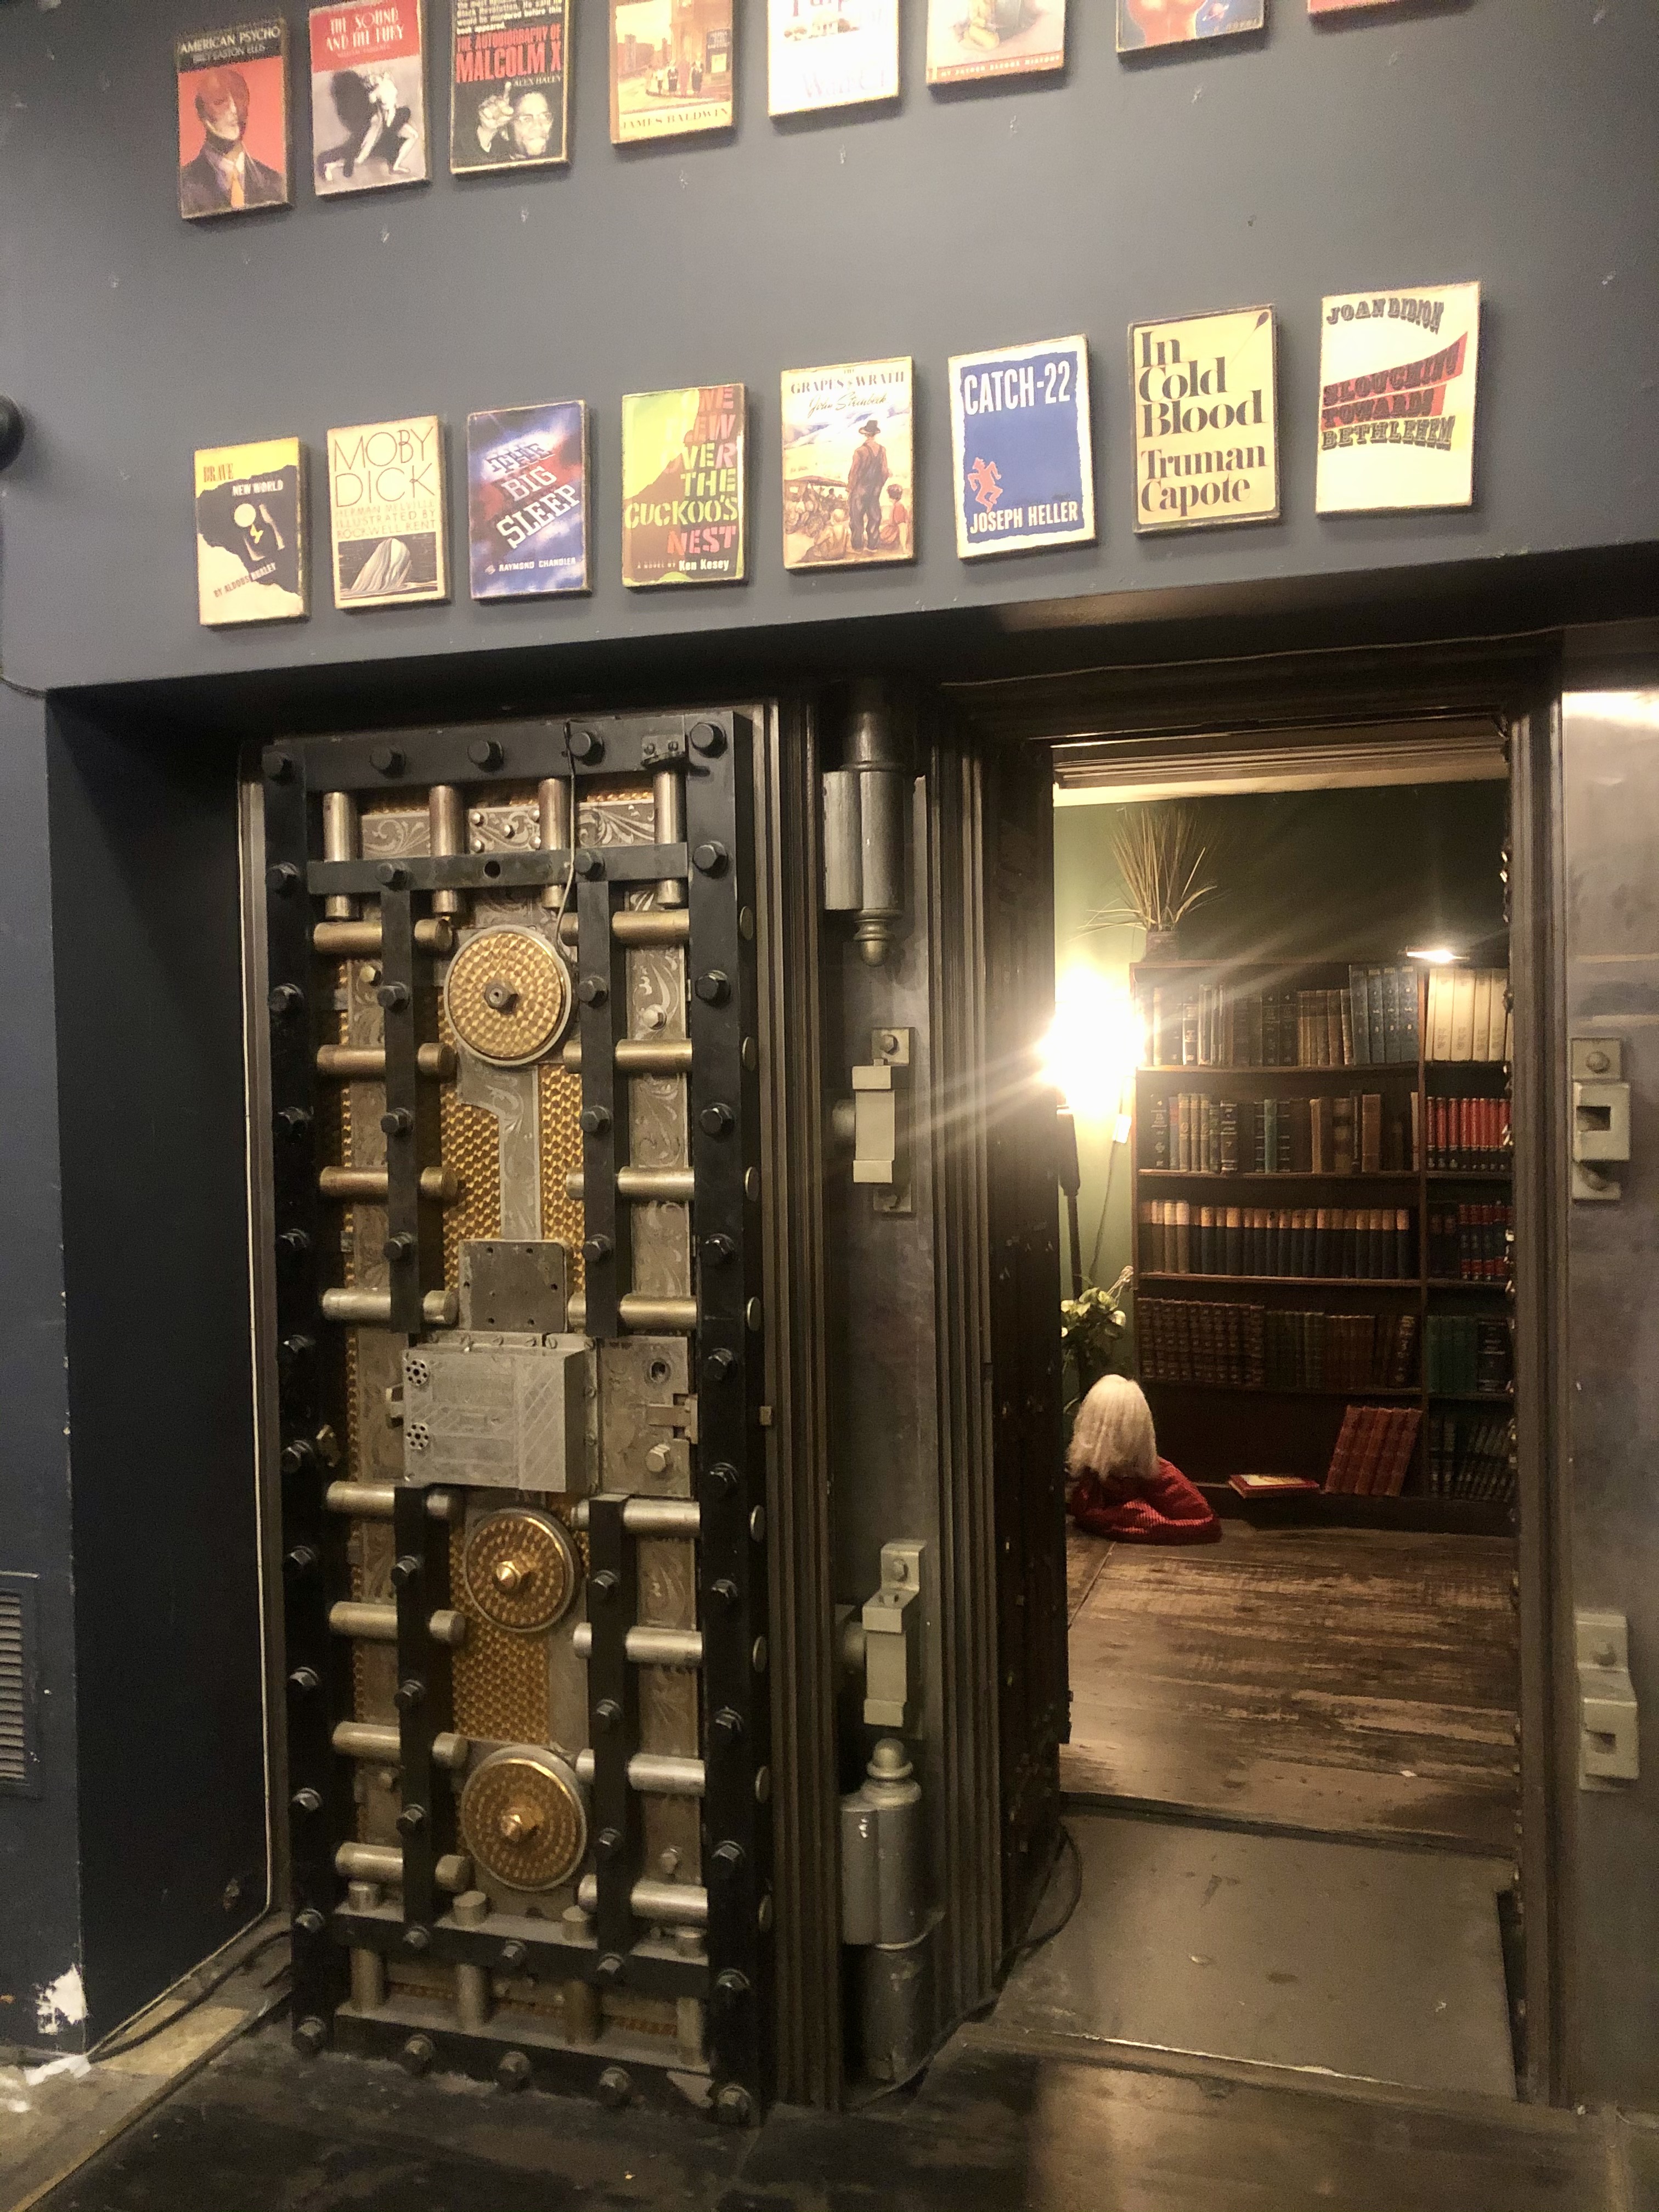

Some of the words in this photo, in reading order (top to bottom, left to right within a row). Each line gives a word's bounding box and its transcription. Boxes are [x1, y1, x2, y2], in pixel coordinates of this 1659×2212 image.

[355, 7, 398, 29] SOUND
[524, 8, 545, 18] before
[180, 34, 235, 53] AMERICAN
[239, 26, 280, 44] PSYCHO
[326, 34, 348, 51] AND
[550, 23, 561, 40] OF
[456, 42, 545, 83] MALCOLM
[550, 41, 562, 72] X
[535, 75, 561, 84] HALEY
[621, 116, 662, 129] JAMES
[666, 108, 727, 123] BALDWIN
[1326, 298, 1386, 325] JOAN
[1387, 298, 1444, 335] DIDION
[1140, 331, 1182, 368] In
[791, 379, 844, 394] GRAPES
[856, 371, 904, 387] WRATH
[964, 360, 1071, 415] CATCH-22
[1139, 356, 1229, 403] Cold
[807, 394, 833, 419] John
[1138, 390, 1267, 438] Blood
[1322, 415, 1455, 451] BETHLEHEM
[334, 426, 435, 472] MOBY
[486, 443, 556, 473] THE
[1141, 444, 1270, 480] Truman
[204, 463, 234, 482] BRAVE
[335, 462, 435, 507] DICK
[501, 465, 557, 501] BIG
[680, 468, 736, 496] THE
[232, 483, 251, 496] NEW
[253, 479, 283, 493] WORLD
[1141, 473, 1251, 516] Capote
[336, 511, 417, 528] ILLUSTRATED
[422, 509, 435, 518] BY
[496, 484, 580, 549] SLEEP
[624, 494, 738, 529] CUCKOO'S
[969, 509, 1023, 534] JOSEPH
[1028, 501, 1079, 525] HELLER
[337, 525, 402, 539] ROCKWELL
[405, 520, 435, 532] KENT
[667, 525, 737, 555] NEST
[499, 561, 535, 572] RAYMOND
[539, 557, 576, 568] CHANDLER
[644, 561, 665, 569] NOVEL
[679, 560, 697, 572] Ken
[700, 558, 730, 572] Kesey
[213, 588, 222, 597] BY
[224, 575, 250, 592] ALDOUS
